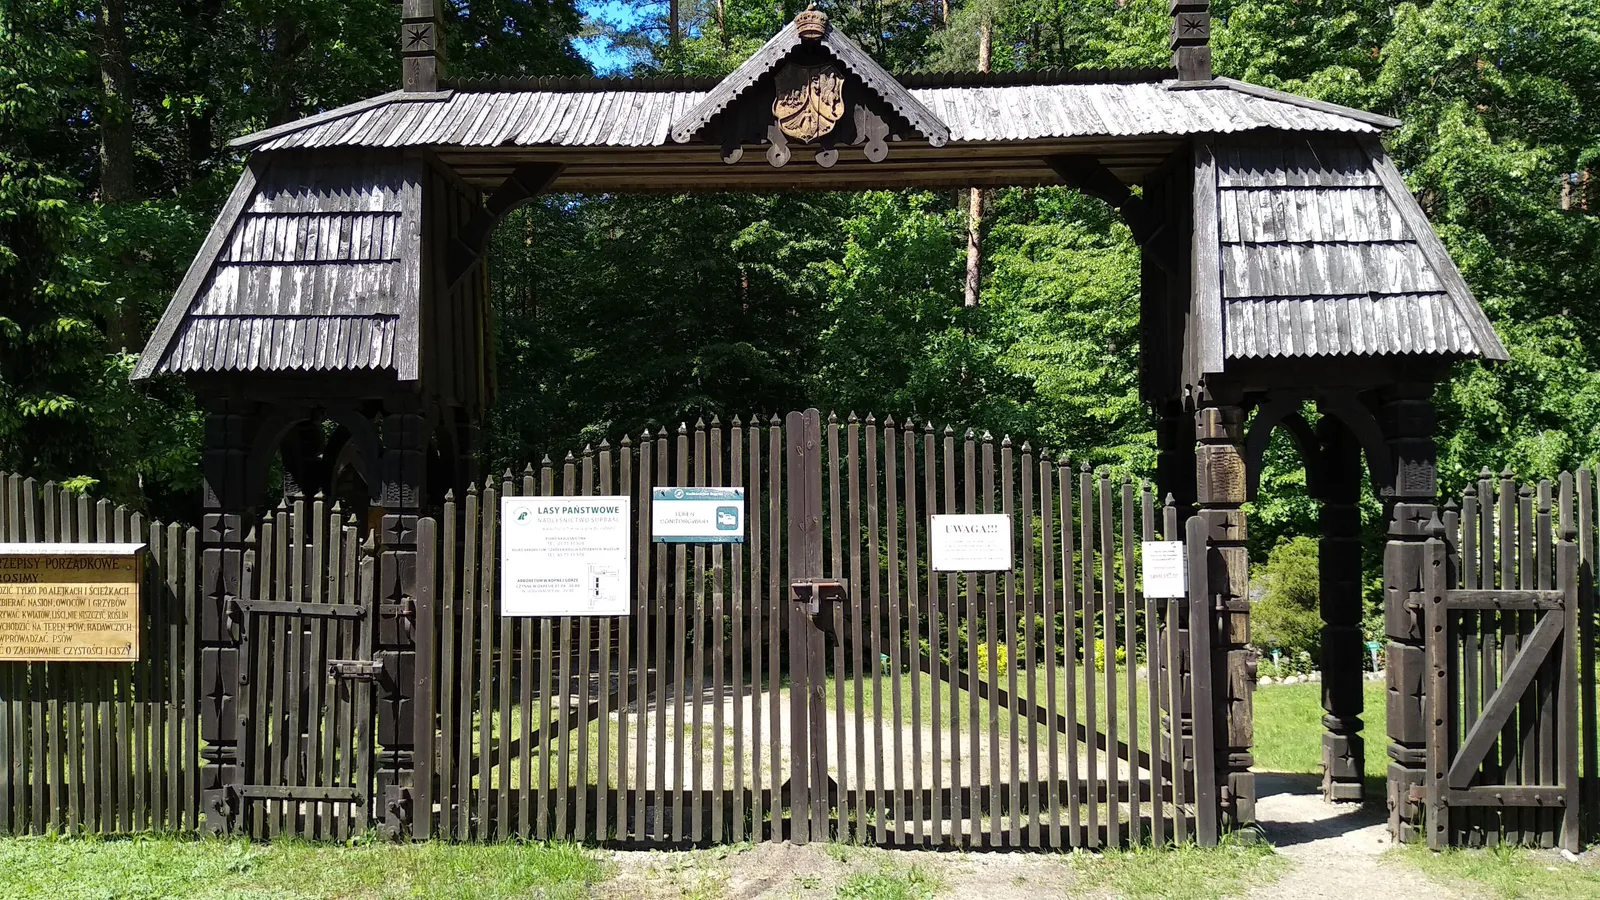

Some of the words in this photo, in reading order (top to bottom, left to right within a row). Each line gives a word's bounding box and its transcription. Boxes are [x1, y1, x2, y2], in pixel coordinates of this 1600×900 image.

[538, 506, 560, 515] LASY
[562, 504, 620, 515] PAŃSTWOWE
[945, 524, 998, 534] UWAGA!!!
[0, 557, 40, 569] ZEPISY
[45, 557, 120, 571] PORZĄDKOWE
[16, 586, 37, 595] TYLKO
[39, 586, 47, 595] PO
[48, 586, 83, 596] ALEJKACH
[89, 585, 129, 596] ŚCIEŻKACH
[93, 597, 127, 608] GRZYBÓW
[79, 609, 106, 620] NISZCZYĆ
[108, 609, 128, 619] ROŚLIN
[32, 622, 42, 631] NA
[44, 622, 66, 631] TEREN
[87, 622, 132, 632] BADAWCZYCH
[52, 632, 73, 643] PSÓW
[5, 646, 12, 655] O
[14, 646, 60, 655] ZACHOWANIE
[64, 644, 103, 656] CZYSTOŚCI
[109, 646, 132, 656] CISZY
